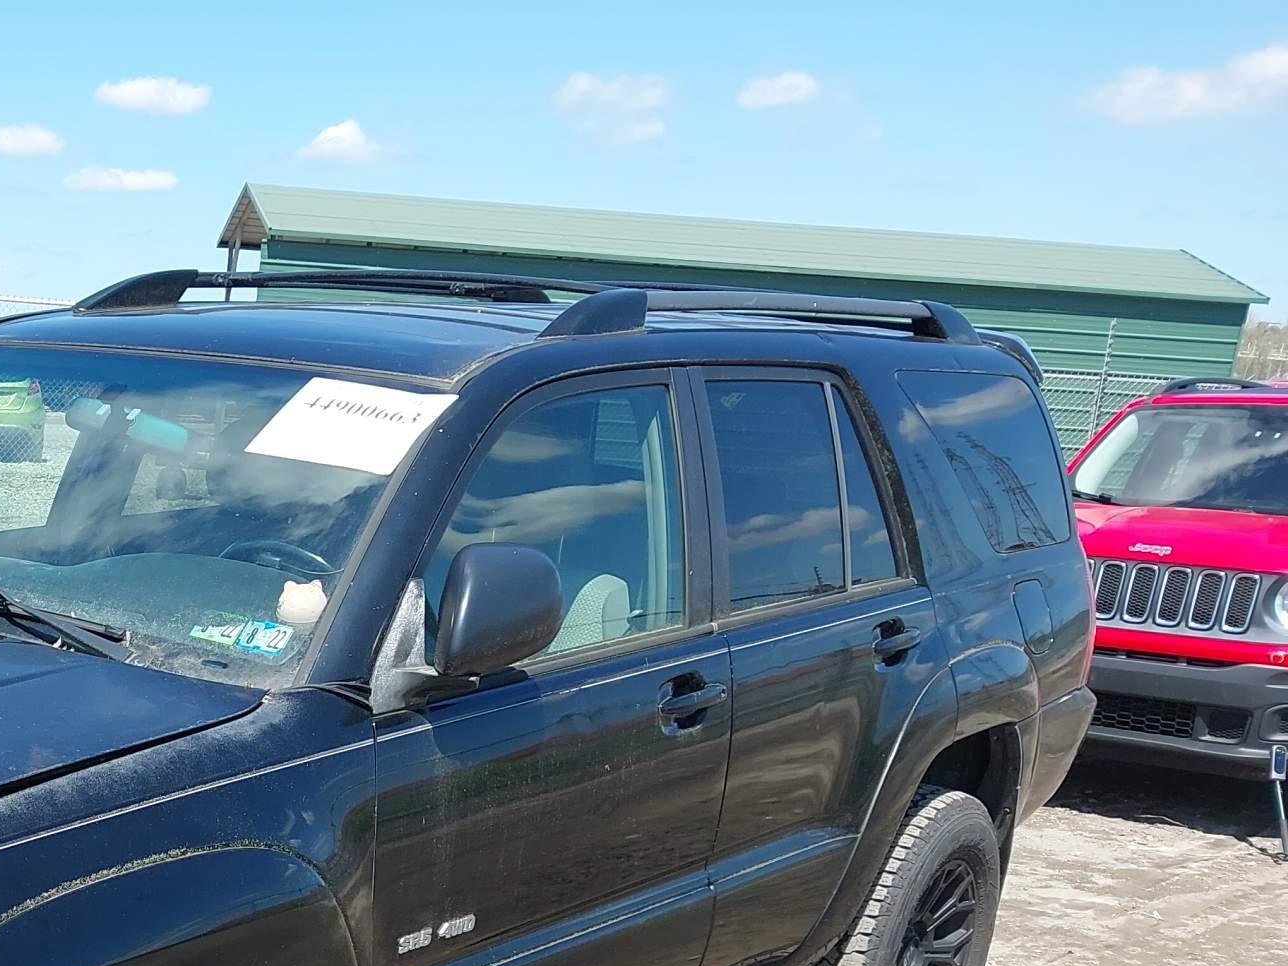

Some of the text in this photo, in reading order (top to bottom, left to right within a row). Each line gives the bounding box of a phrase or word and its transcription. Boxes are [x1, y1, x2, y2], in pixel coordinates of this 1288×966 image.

[304, 397, 421, 424] 44900663
[1129, 543, 1171, 556] Jeep
[398, 914, 475, 954] SR5 4WD
